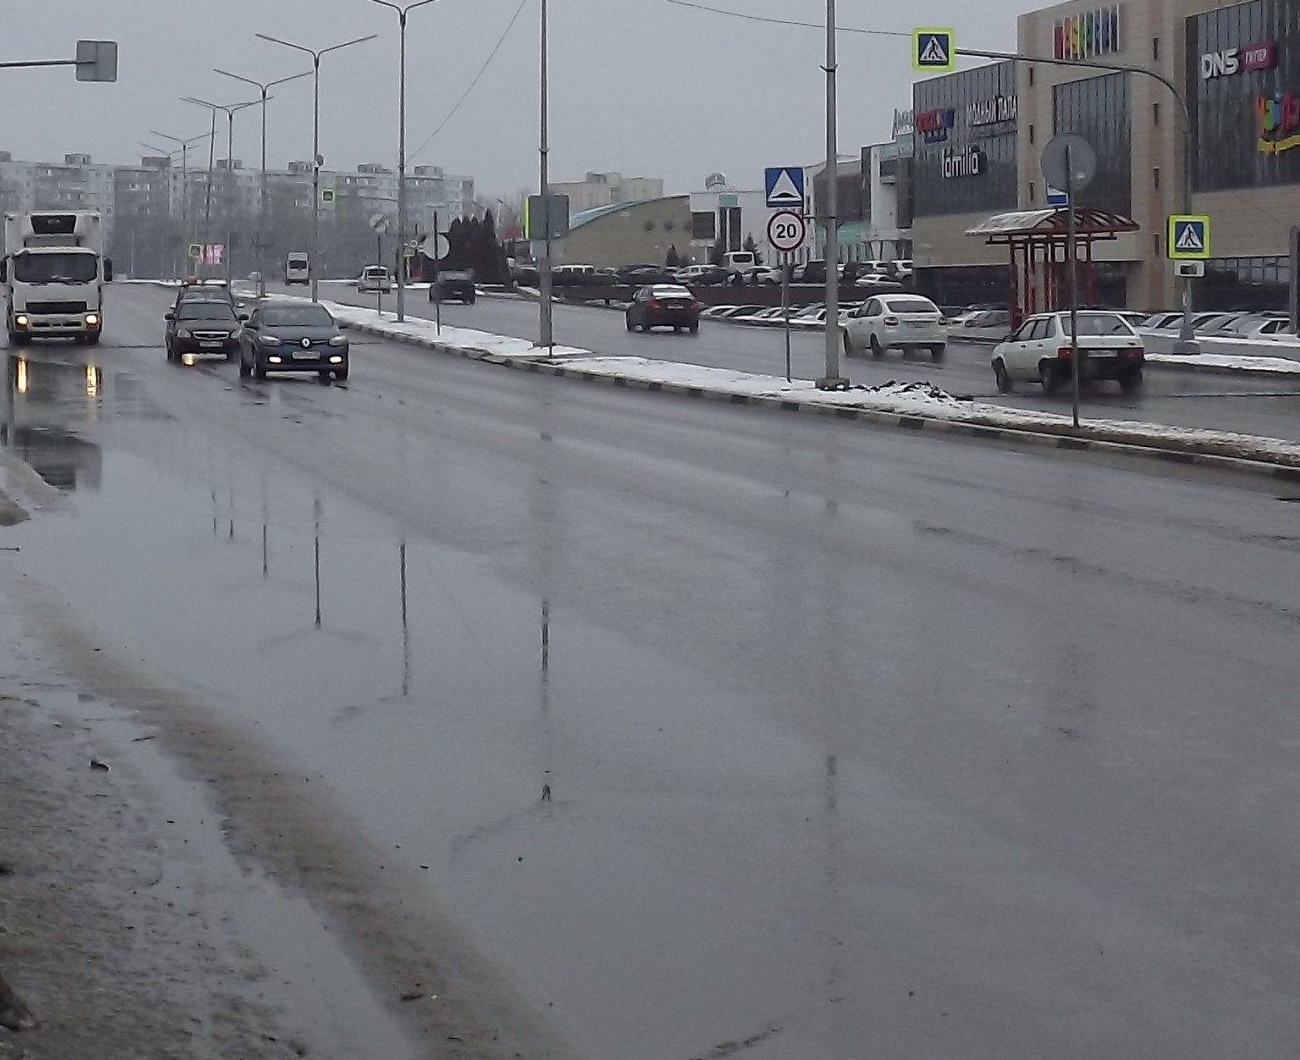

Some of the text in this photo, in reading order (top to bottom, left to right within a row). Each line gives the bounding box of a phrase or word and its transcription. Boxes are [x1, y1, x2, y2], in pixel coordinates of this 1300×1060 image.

[1201, 48, 1240, 79] DNS
[941, 144, 979, 179] familia
[776, 223, 797, 239] 20
